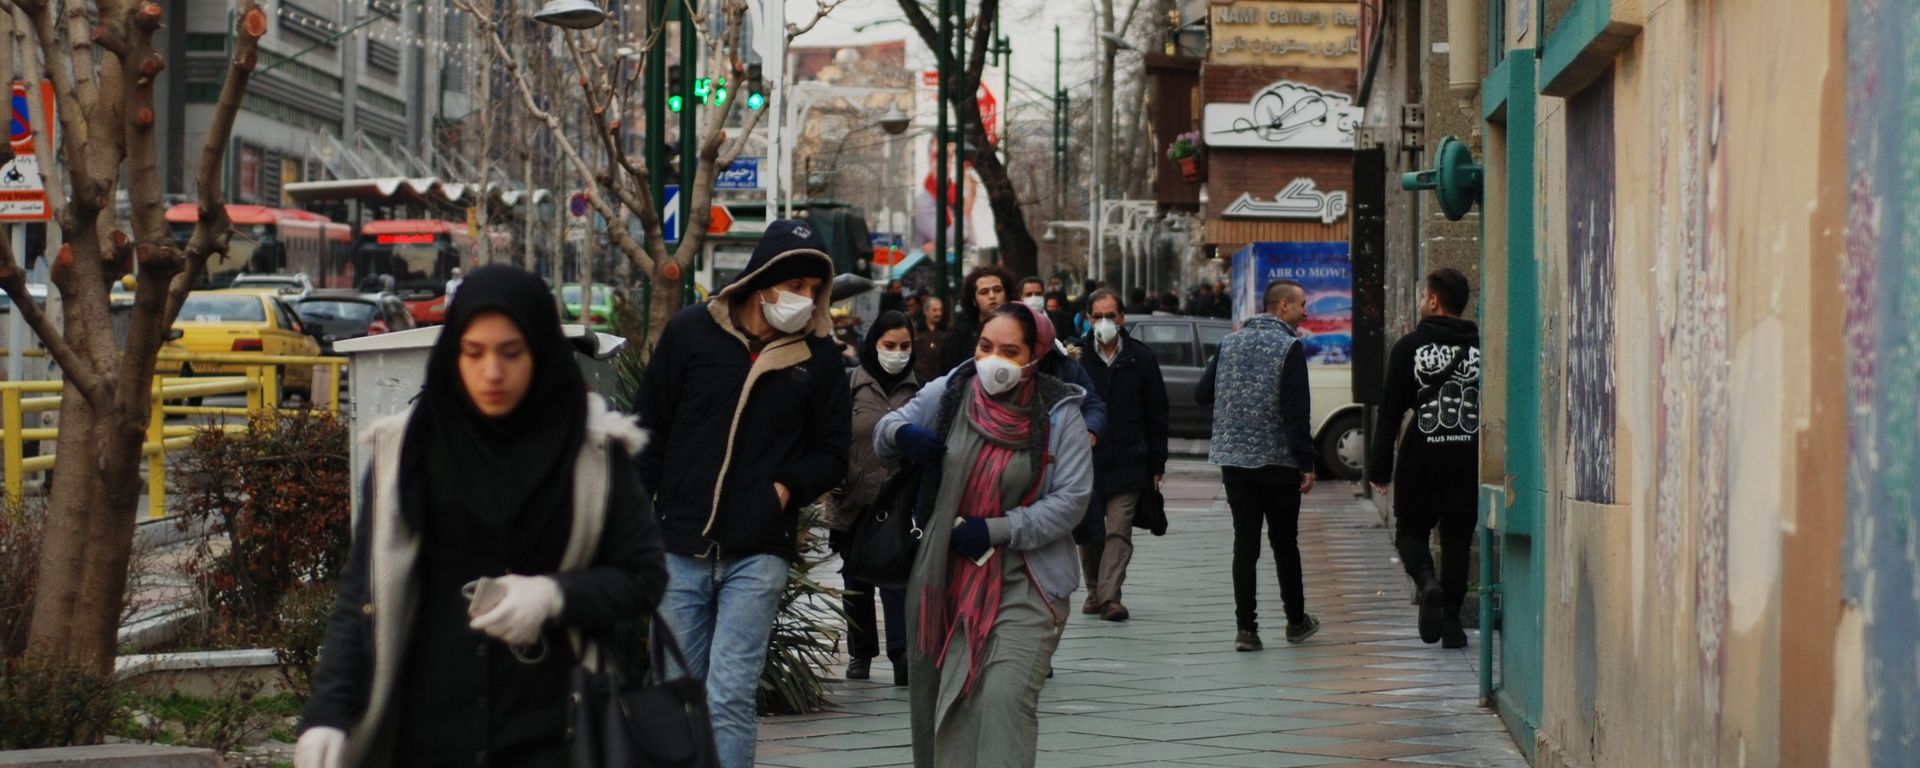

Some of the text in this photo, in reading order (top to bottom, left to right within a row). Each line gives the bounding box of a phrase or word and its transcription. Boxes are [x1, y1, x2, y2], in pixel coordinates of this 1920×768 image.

[1267, 7, 1327, 28] Gallery
[1268, 268, 1293, 278] ABR
[1296, 268, 1306, 278] O
[1427, 435, 1445, 443] PLUS
